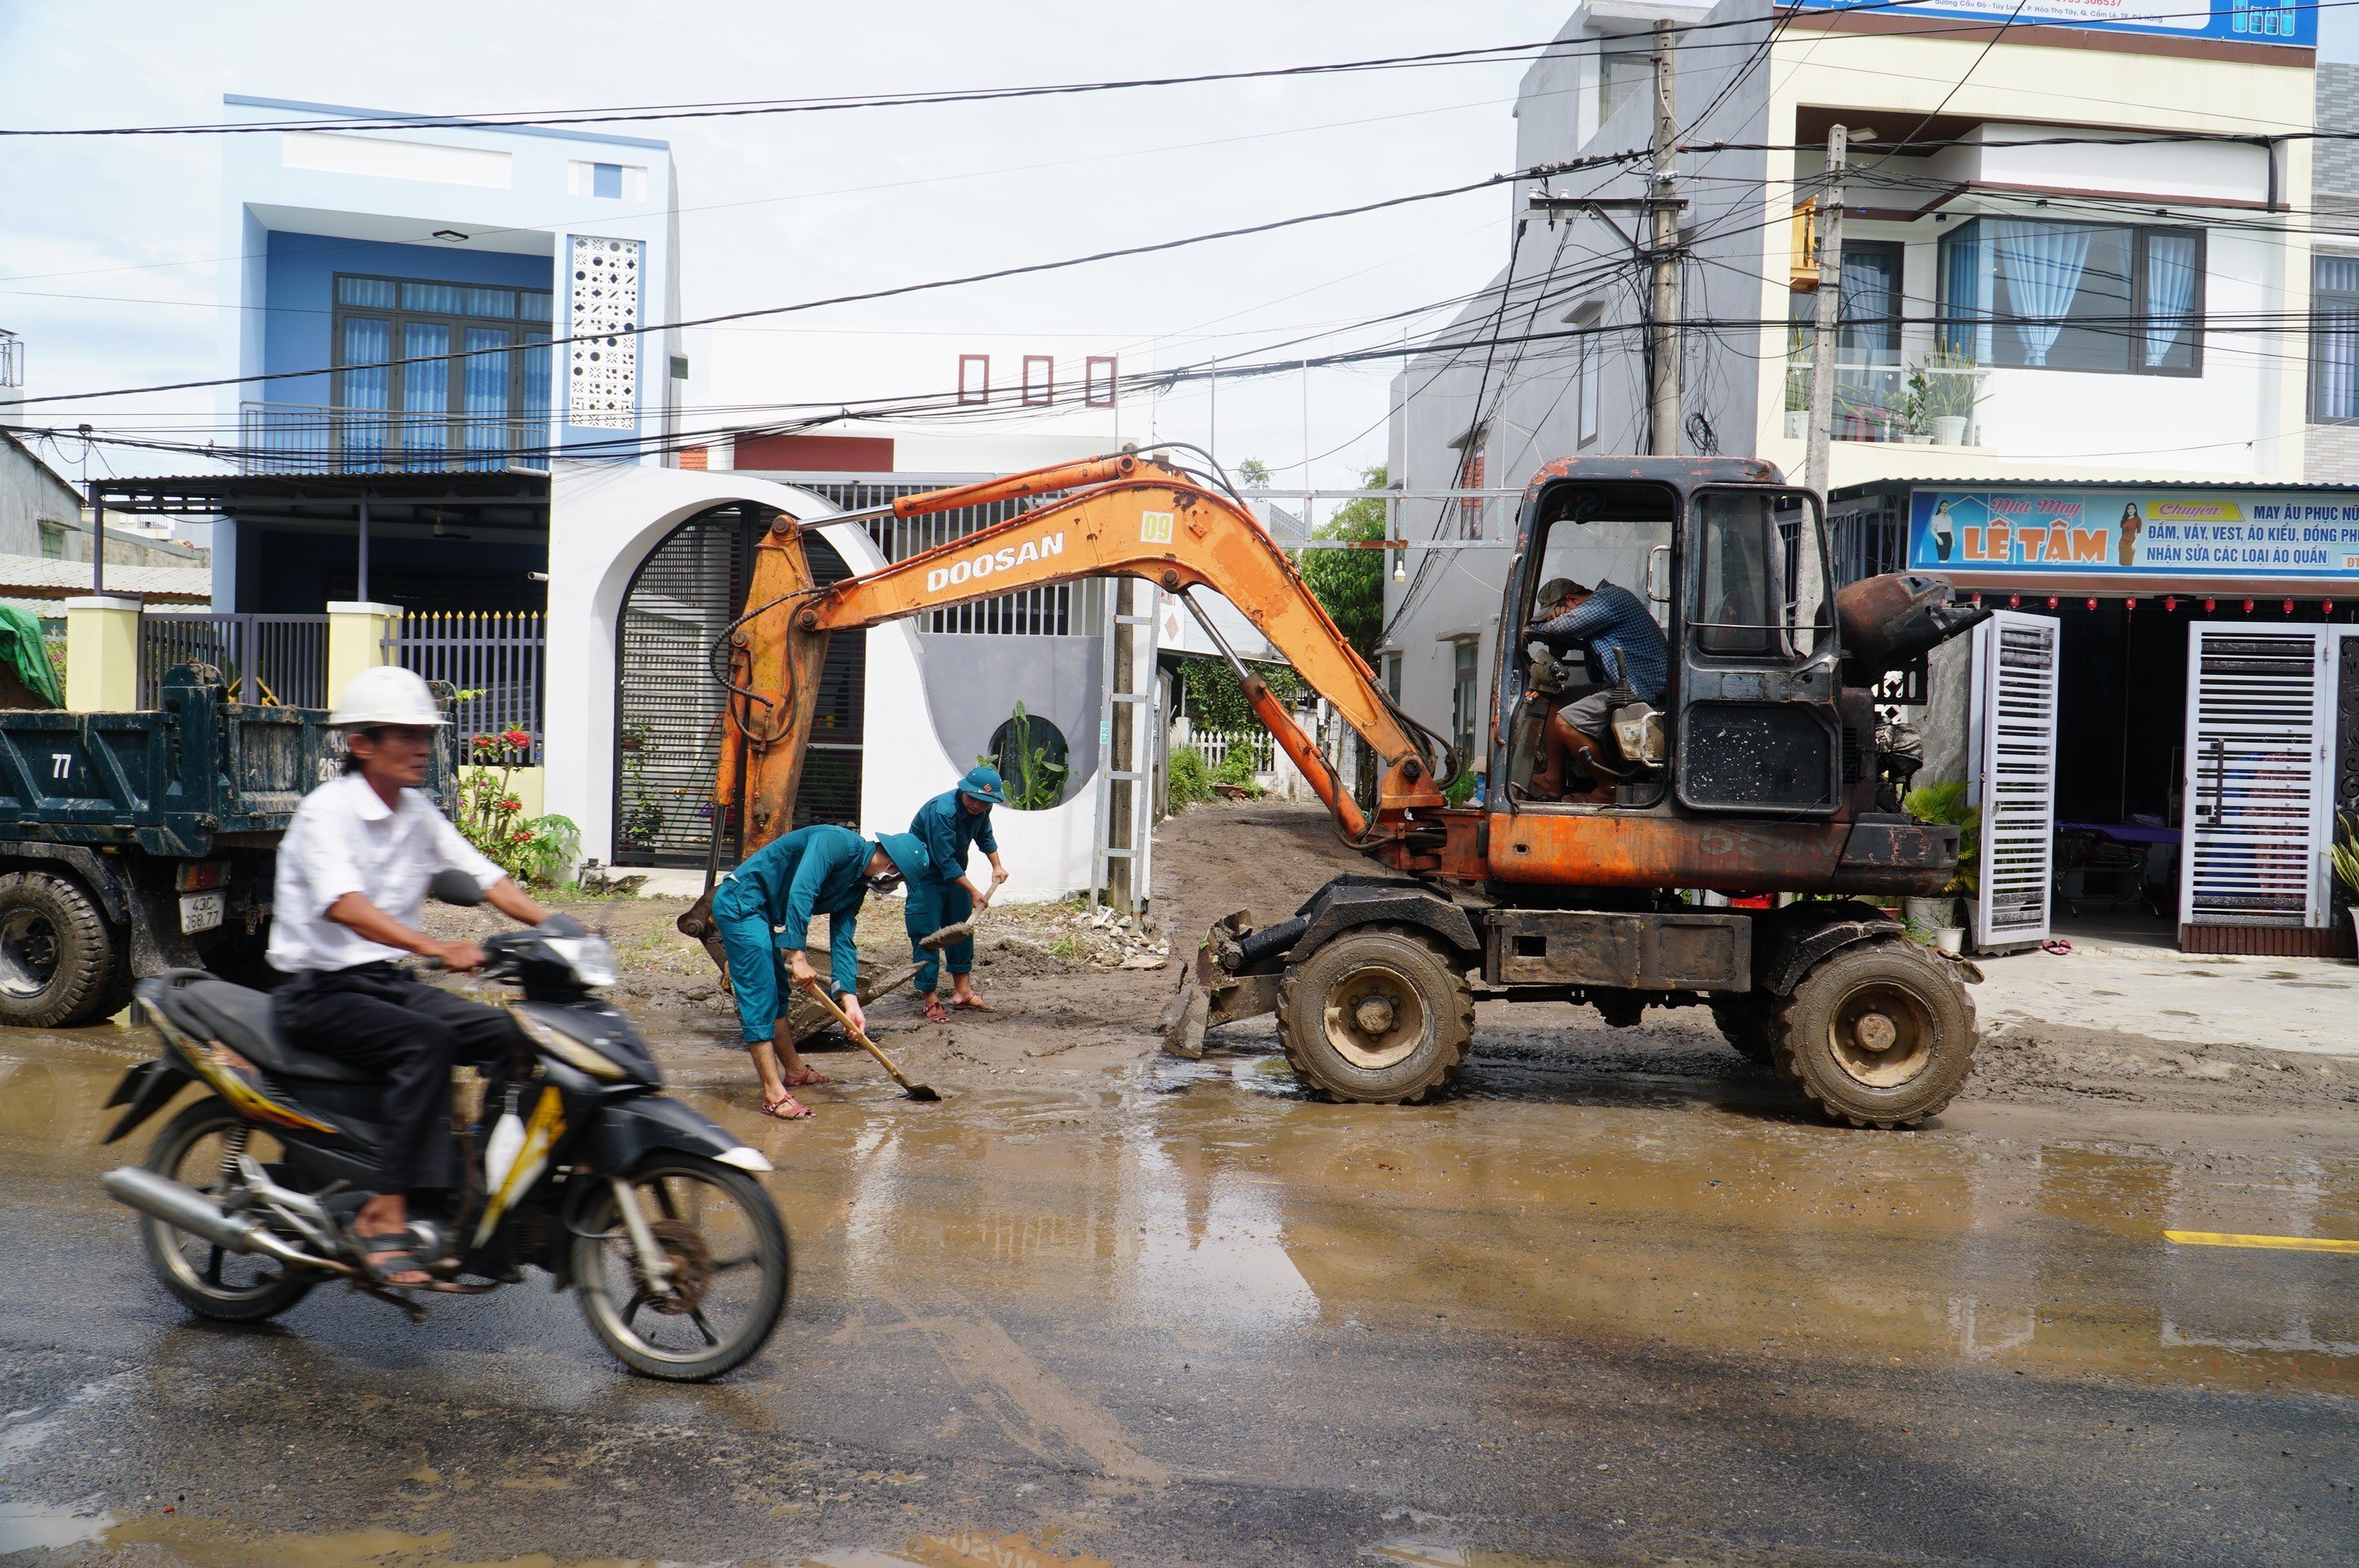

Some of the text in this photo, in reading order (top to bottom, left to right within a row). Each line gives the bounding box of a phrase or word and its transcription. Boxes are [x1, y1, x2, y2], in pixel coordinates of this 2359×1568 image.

[1991, 497, 2083, 518] Nhà May
[2158, 503, 2226, 519] Chuyên:
[2254, 506, 2281, 520] MAY
[2284, 503, 2301, 520] ÂU
[2304, 506, 2338, 524] PHỤC
[1143, 514, 1171, 541] 09
[2183, 524, 2208, 542] VÁY,
[2212, 526, 2244, 543] VEST,
[2247, 524, 2264, 541] ÁO
[2268, 522, 2299, 543] KIỂU,
[2303, 523, 2337, 542] ĐỒNG
[2341, 528, 2359, 542] PH
[1964, 518, 2011, 561] LÊ
[926, 532, 1064, 593] DOOSAN
[2146, 543, 2328, 566] NHẬN SỬA CÁC LOẠI ÁO QUẦN
[52, 753, 72, 779] 77
[192, 896, 213, 912] 43C
